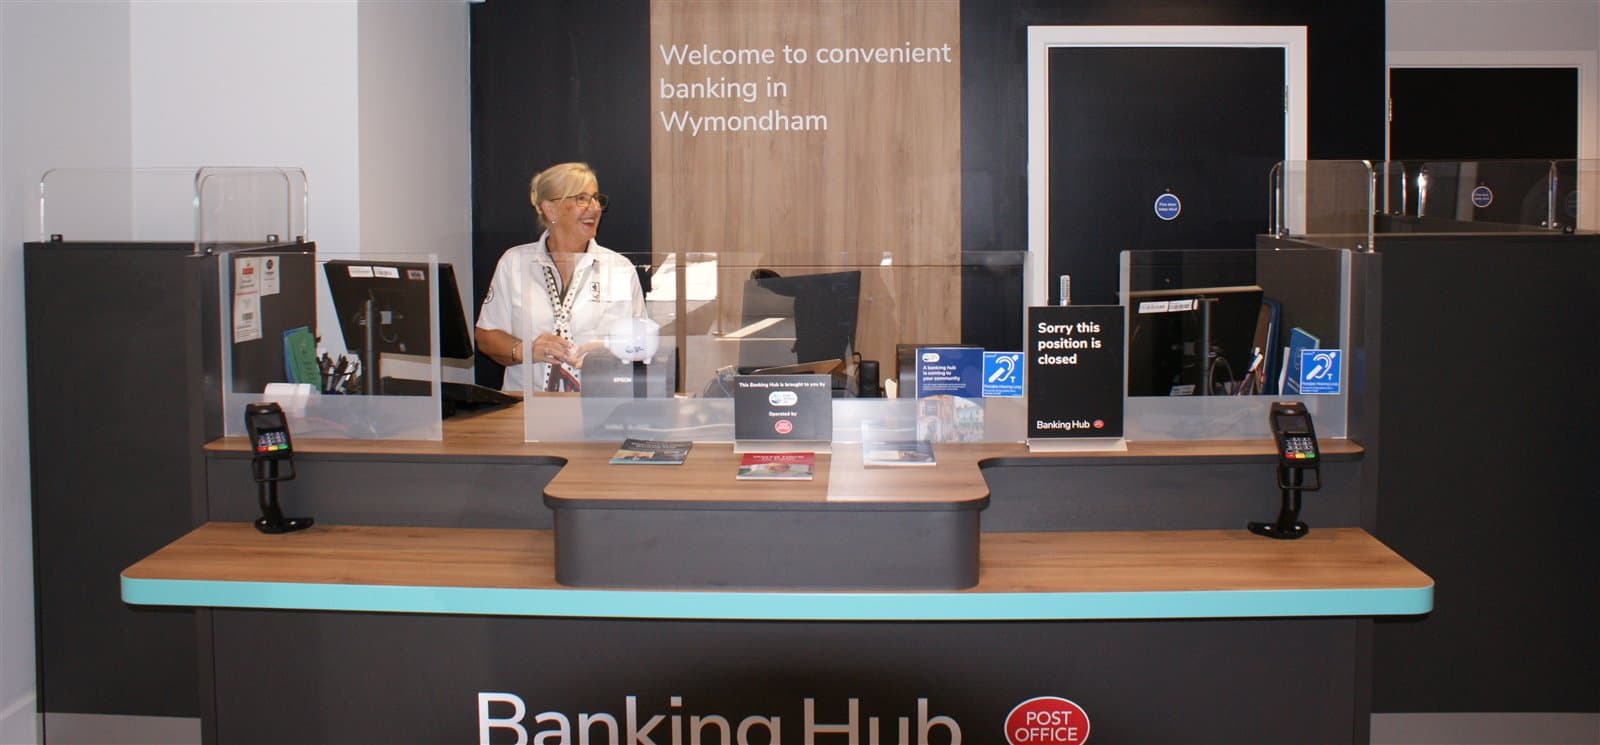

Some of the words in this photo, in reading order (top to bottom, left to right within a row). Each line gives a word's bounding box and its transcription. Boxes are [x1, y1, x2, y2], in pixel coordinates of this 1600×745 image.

[660, 44, 775, 65] Welcome
[783, 45, 808, 64] to
[816, 42, 951, 64] convenient
[660, 77, 757, 102] banking
[766, 76, 788, 98] in
[660, 110, 828, 136] Wymondham
[1038, 322, 1073, 335] Sorry
[1076, 322, 1101, 333] this
[1038, 338, 1088, 351] position
[1091, 338, 1101, 348] is
[1038, 354, 1078, 365] closed
[1036, 421, 1071, 431] Banking
[1072, 420, 1091, 429] Hub
[478, 692, 781, 745] Banking
[804, 697, 962, 745] Hub
[1026, 711, 1072, 725] POST
[1014, 728, 1078, 743] OFFICE
